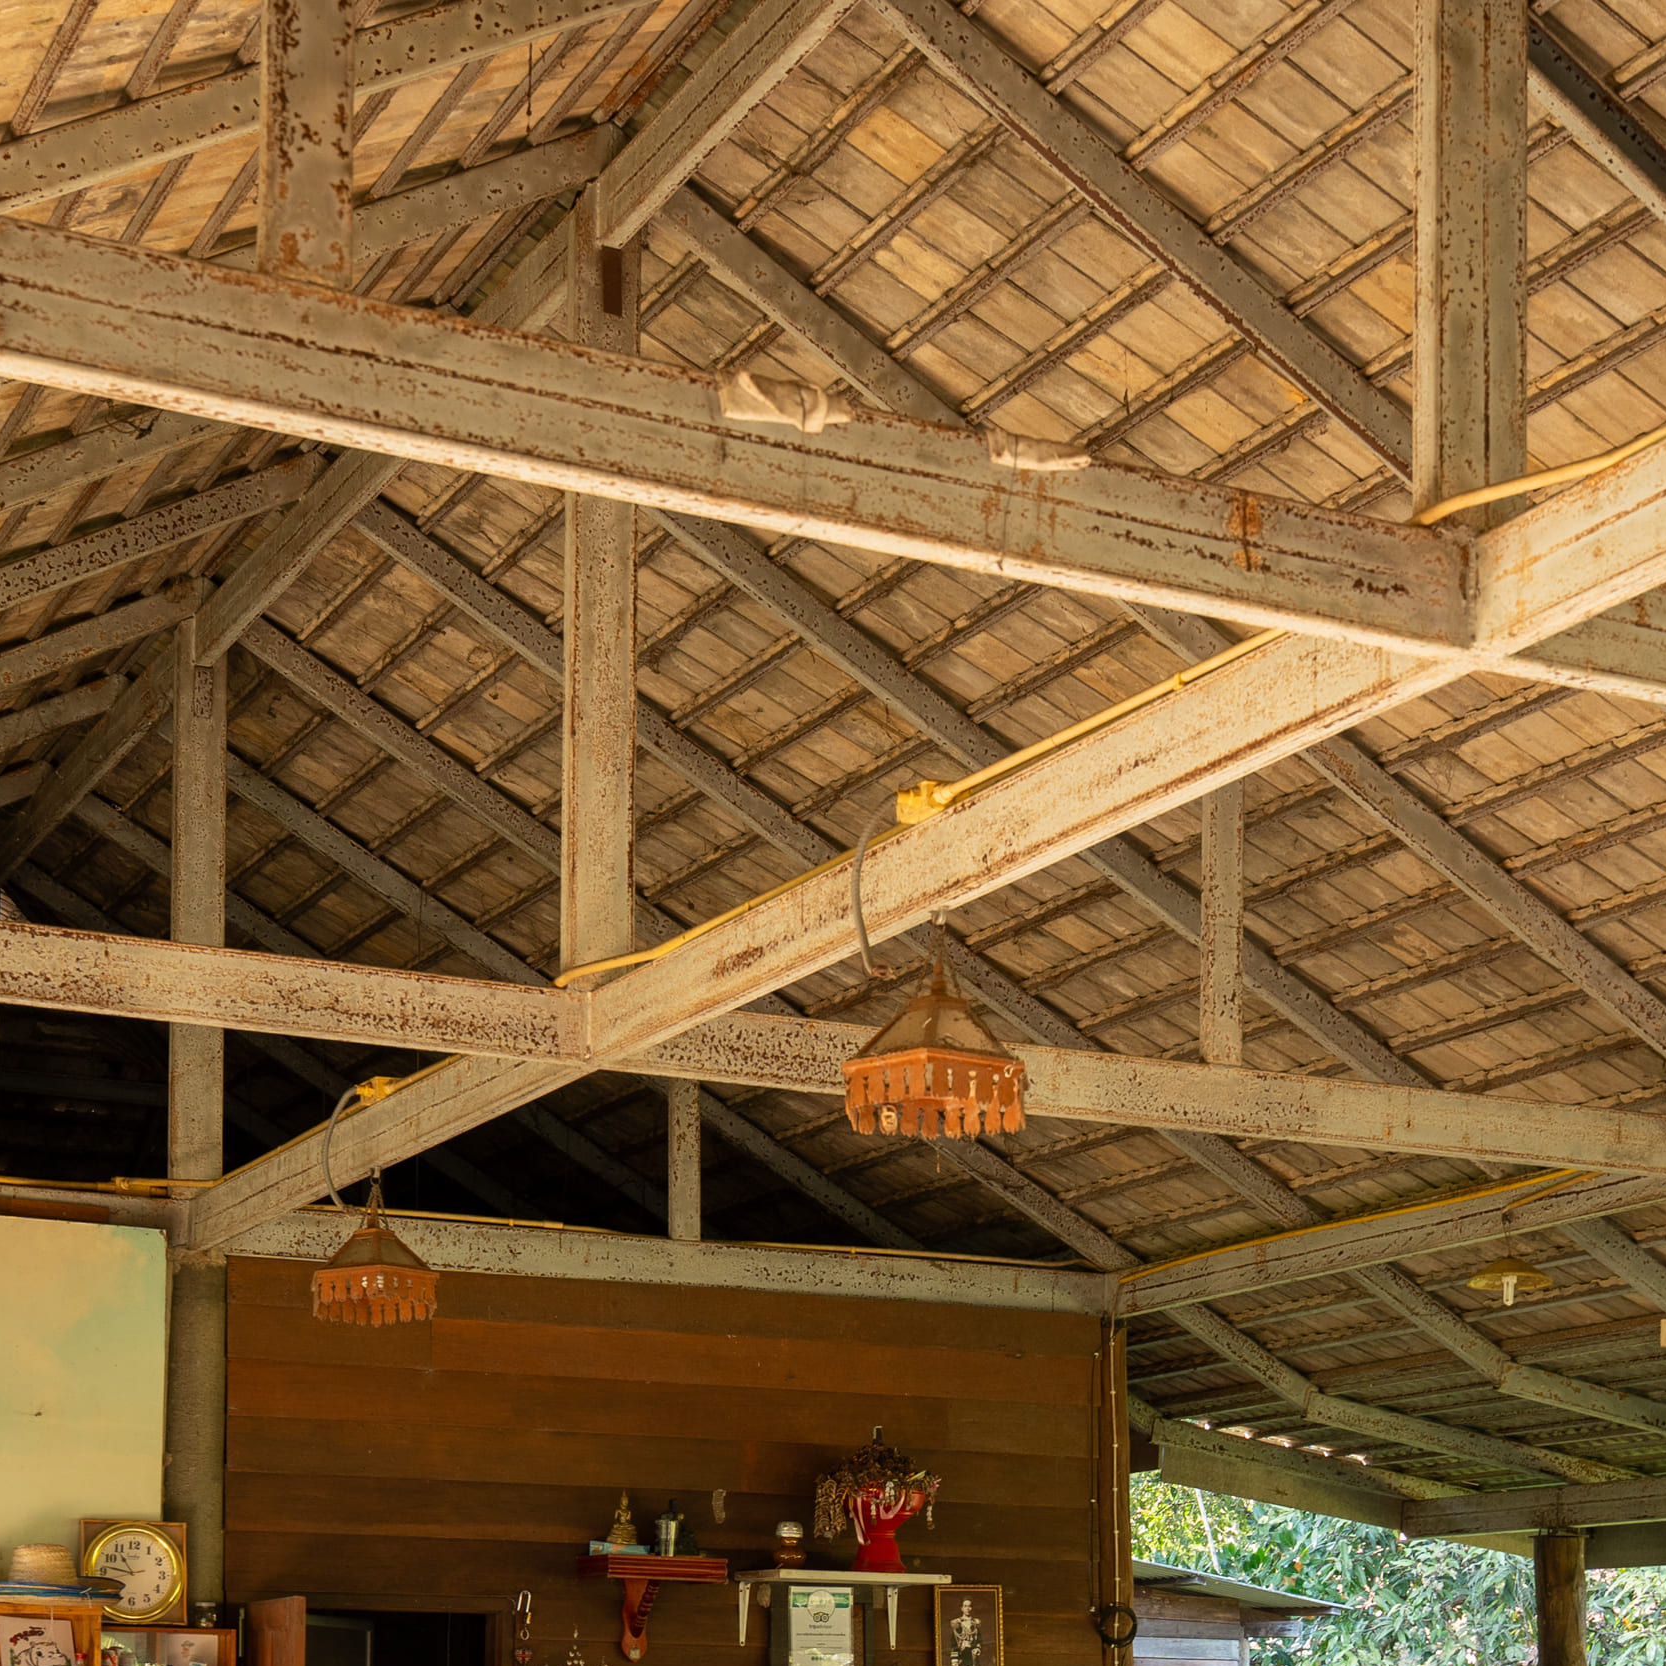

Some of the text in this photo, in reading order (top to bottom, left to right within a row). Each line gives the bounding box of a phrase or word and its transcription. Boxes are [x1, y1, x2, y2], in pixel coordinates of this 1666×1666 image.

[115, 1543, 124, 1553] 11
[128, 1541, 141, 1550] 12
[146, 1546, 152, 1555] 1
[105, 1554, 117, 1563] 10
[155, 1557, 163, 1566] 2
[100, 1567, 107, 1576] 9
[158, 1571, 166, 1580] 3
[153, 1584, 160, 1594] 4
[128, 1597, 135, 1606] 6
[143, 1594, 151, 1603] 5
